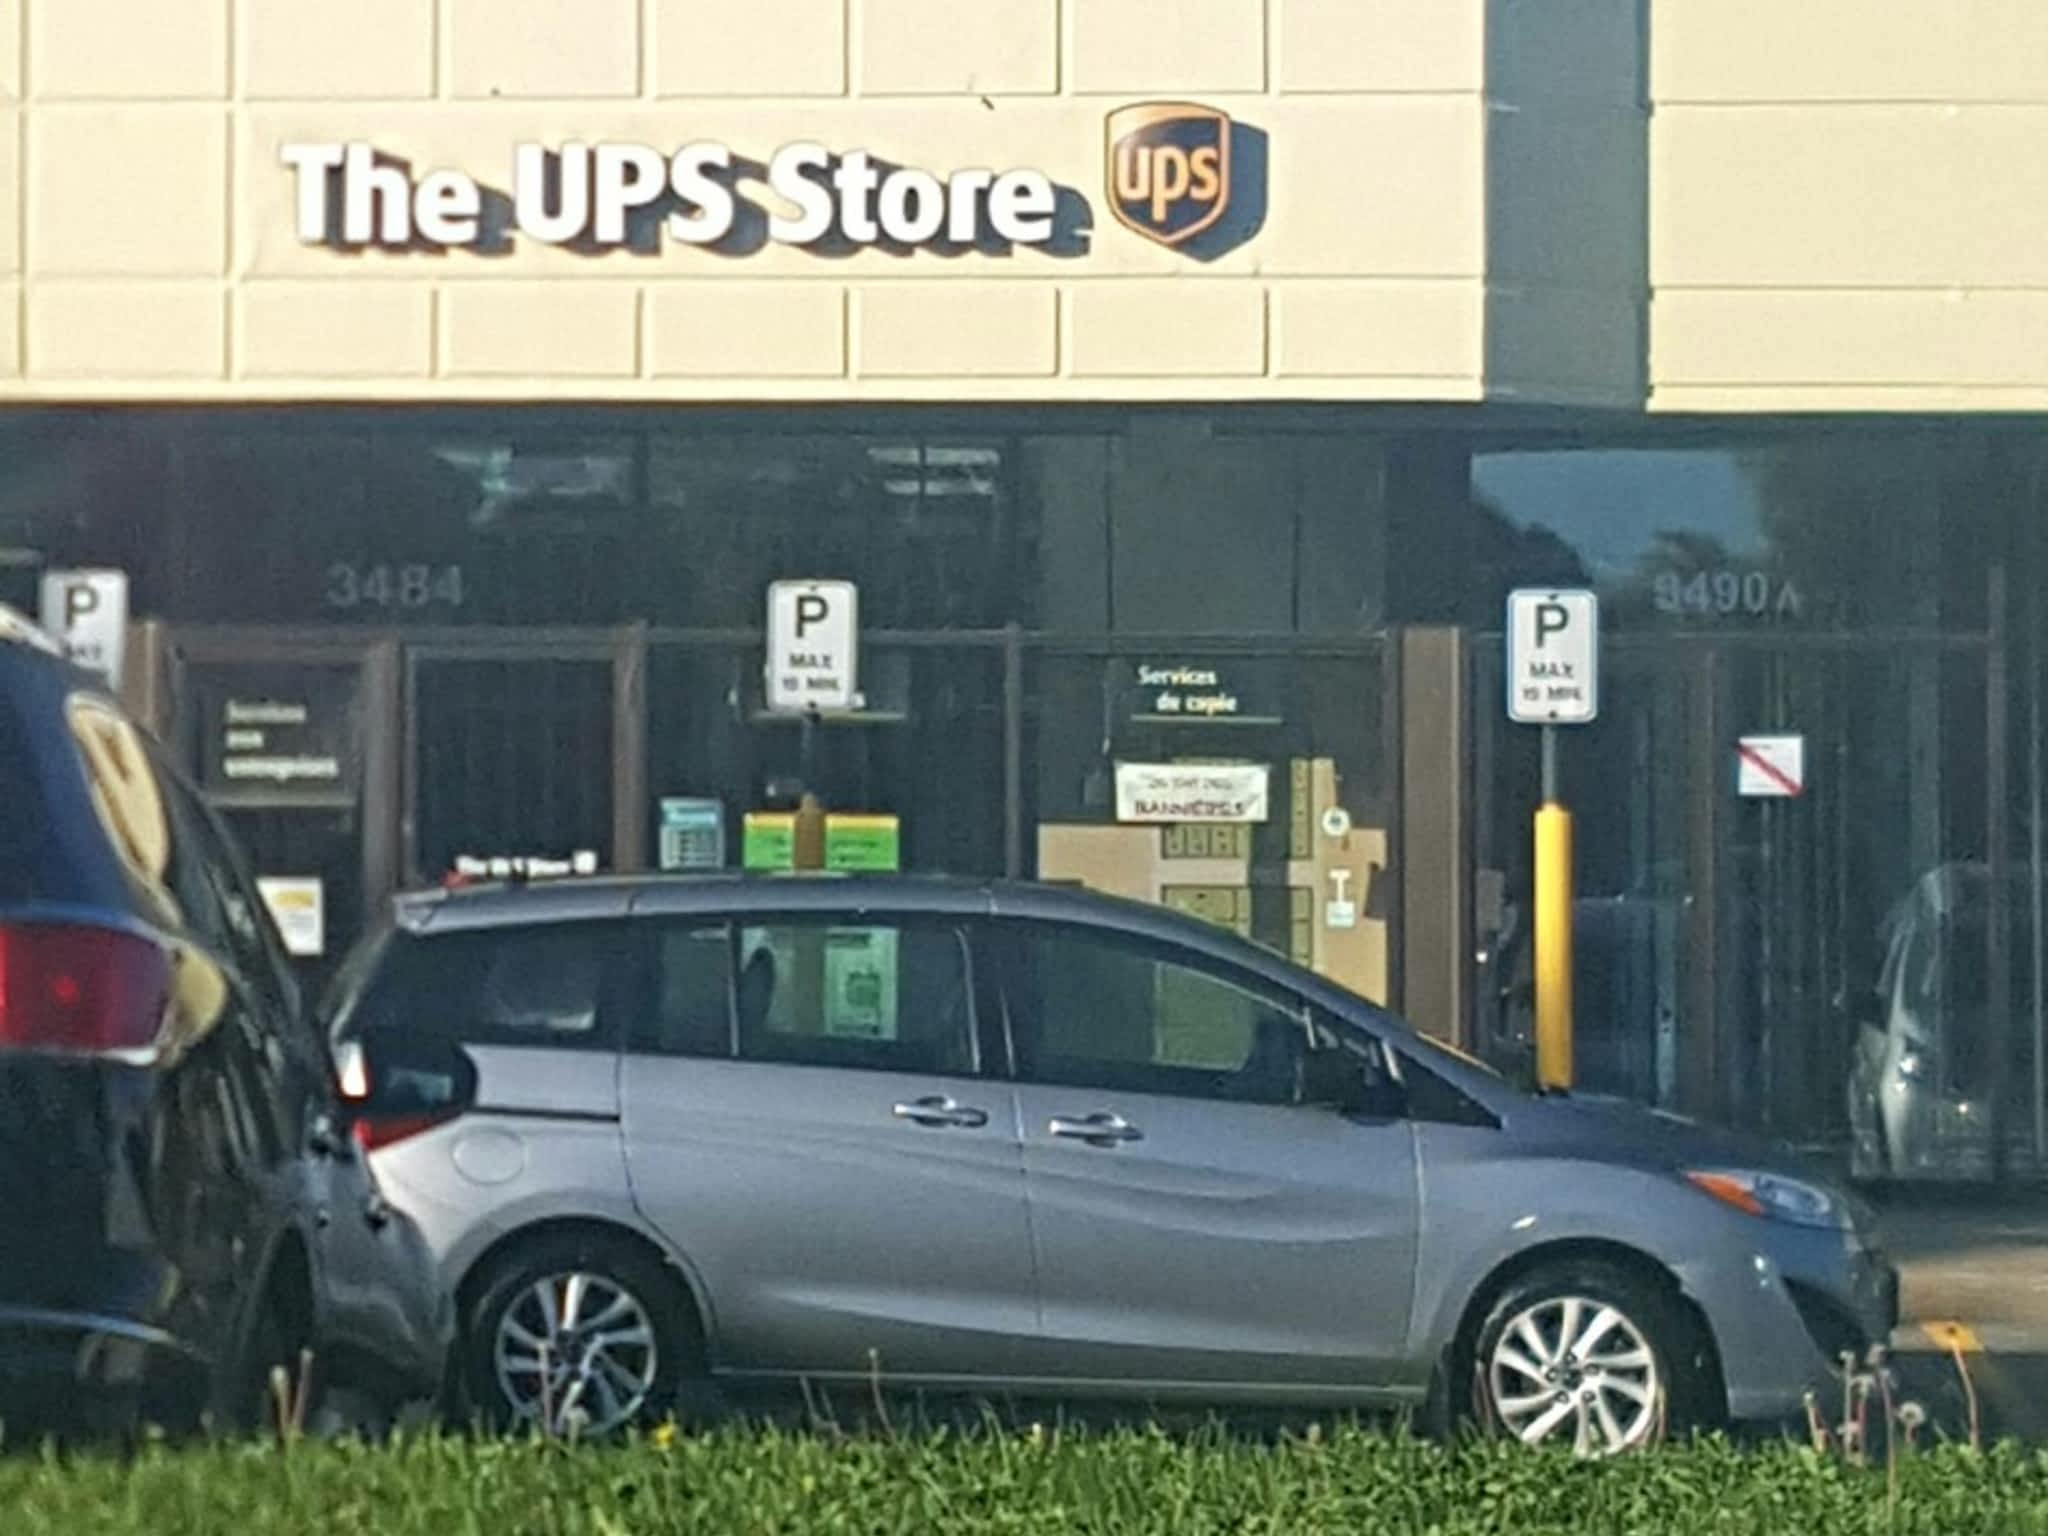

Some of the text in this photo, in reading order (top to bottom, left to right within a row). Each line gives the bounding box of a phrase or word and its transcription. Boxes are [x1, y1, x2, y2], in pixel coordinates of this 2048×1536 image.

[282, 145, 1056, 246] The UPS Store
[1116, 146, 1220, 223] ups
[64, 585, 99, 629] P
[329, 564, 463, 606] 3484
[796, 594, 829, 639] P
[1535, 603, 1569, 649] P
[1137, 665, 1217, 685] Services
[1529, 662, 1574, 679] MAX
